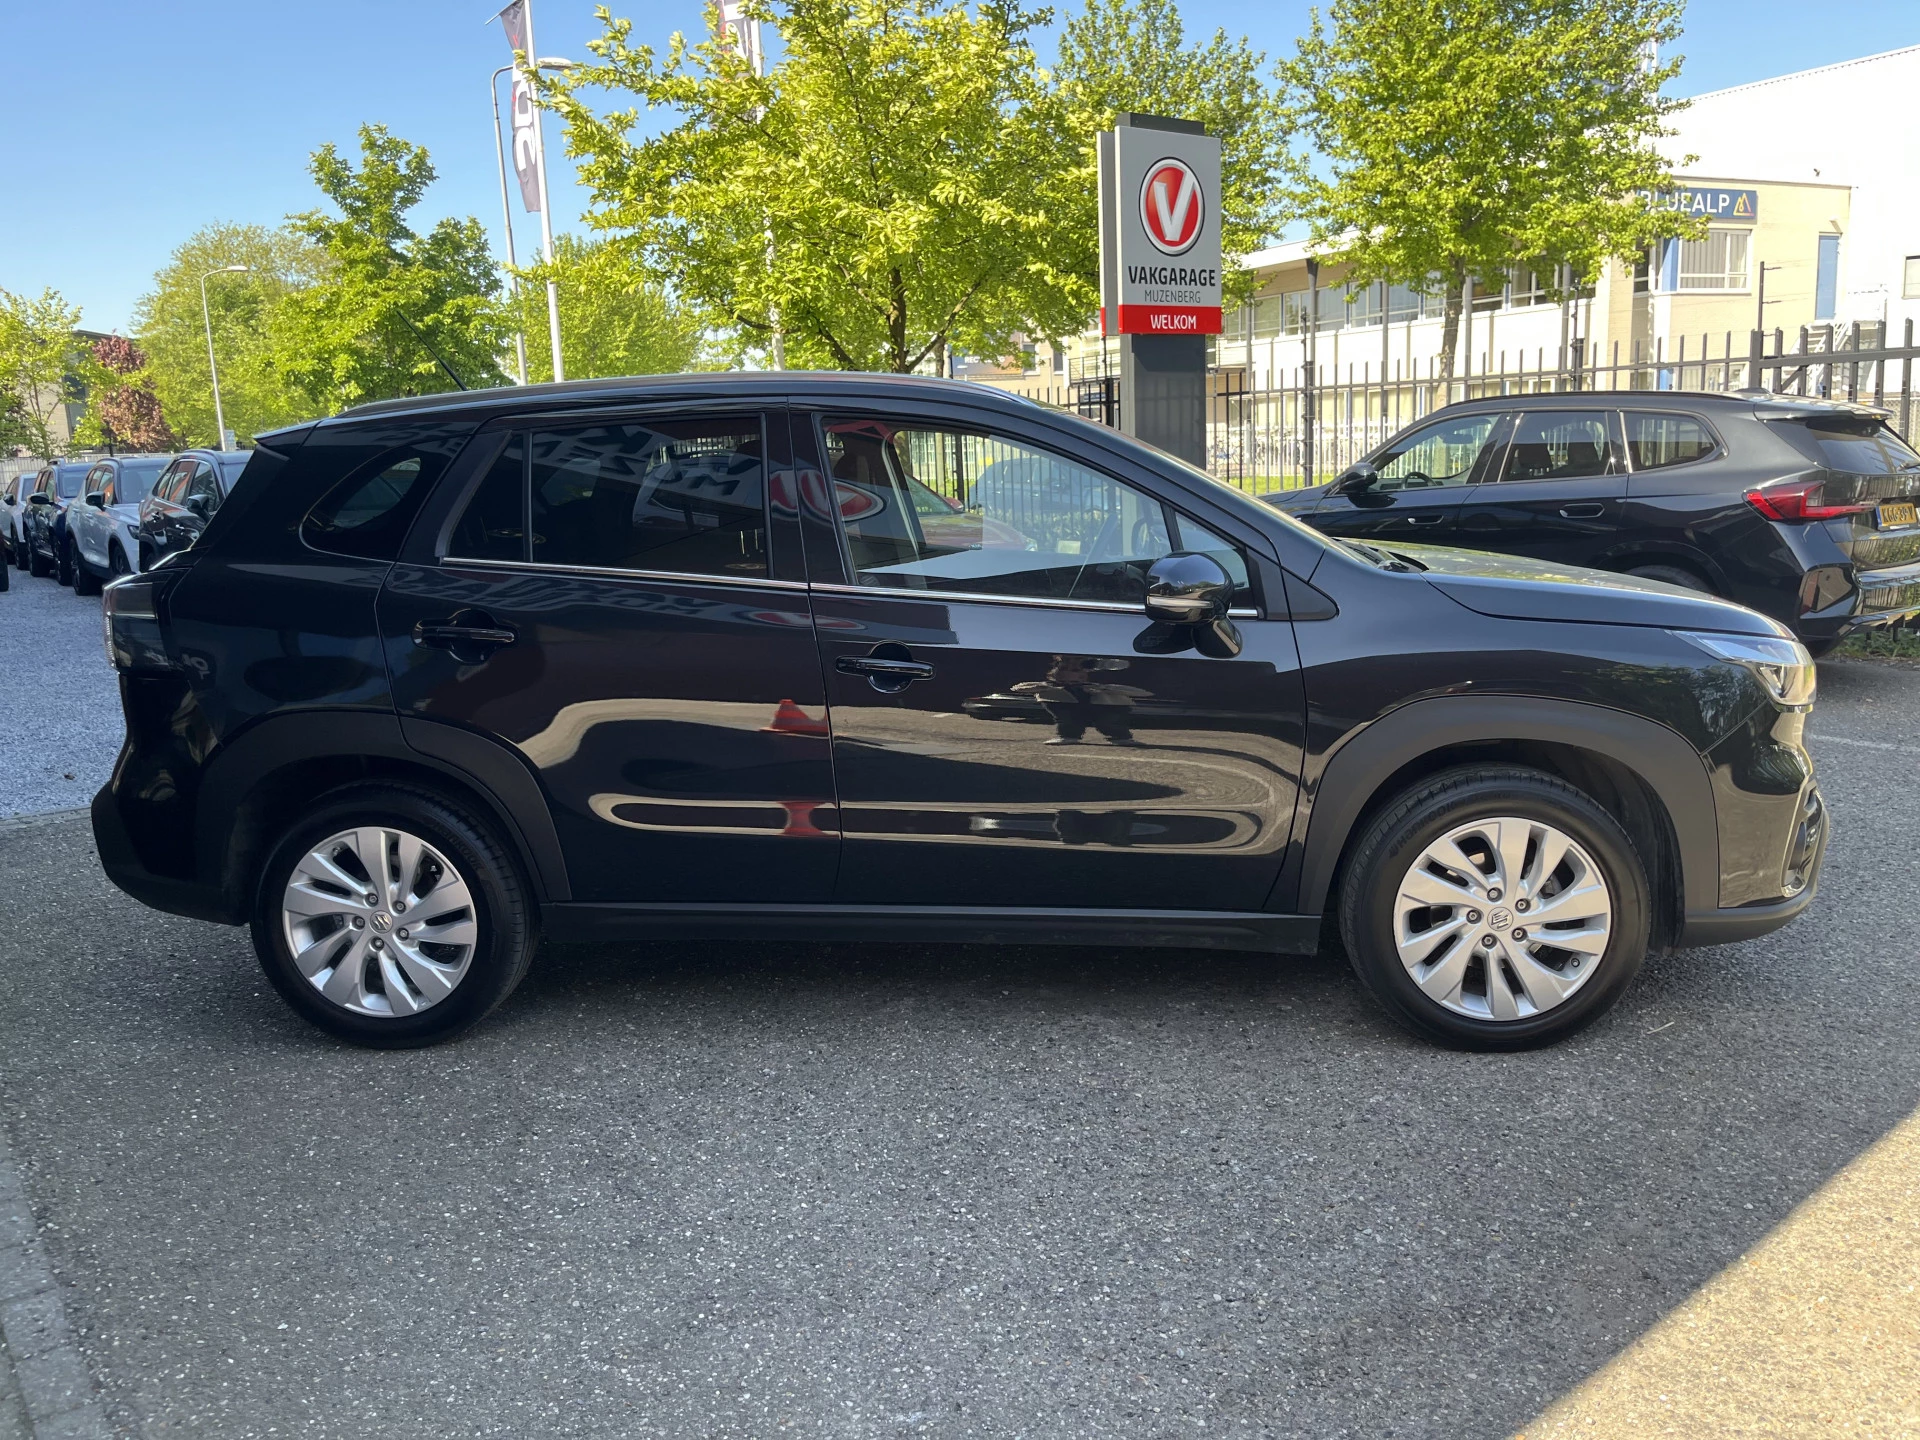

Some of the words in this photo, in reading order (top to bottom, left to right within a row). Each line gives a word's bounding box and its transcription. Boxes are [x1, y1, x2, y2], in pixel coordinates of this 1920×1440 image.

[1640, 191, 1730, 213] BLUEALP
[1128, 265, 1216, 286] VAKGARAGE
[1144, 289, 1201, 304] MUZENBERG
[1150, 313, 1197, 330] WELKOM
